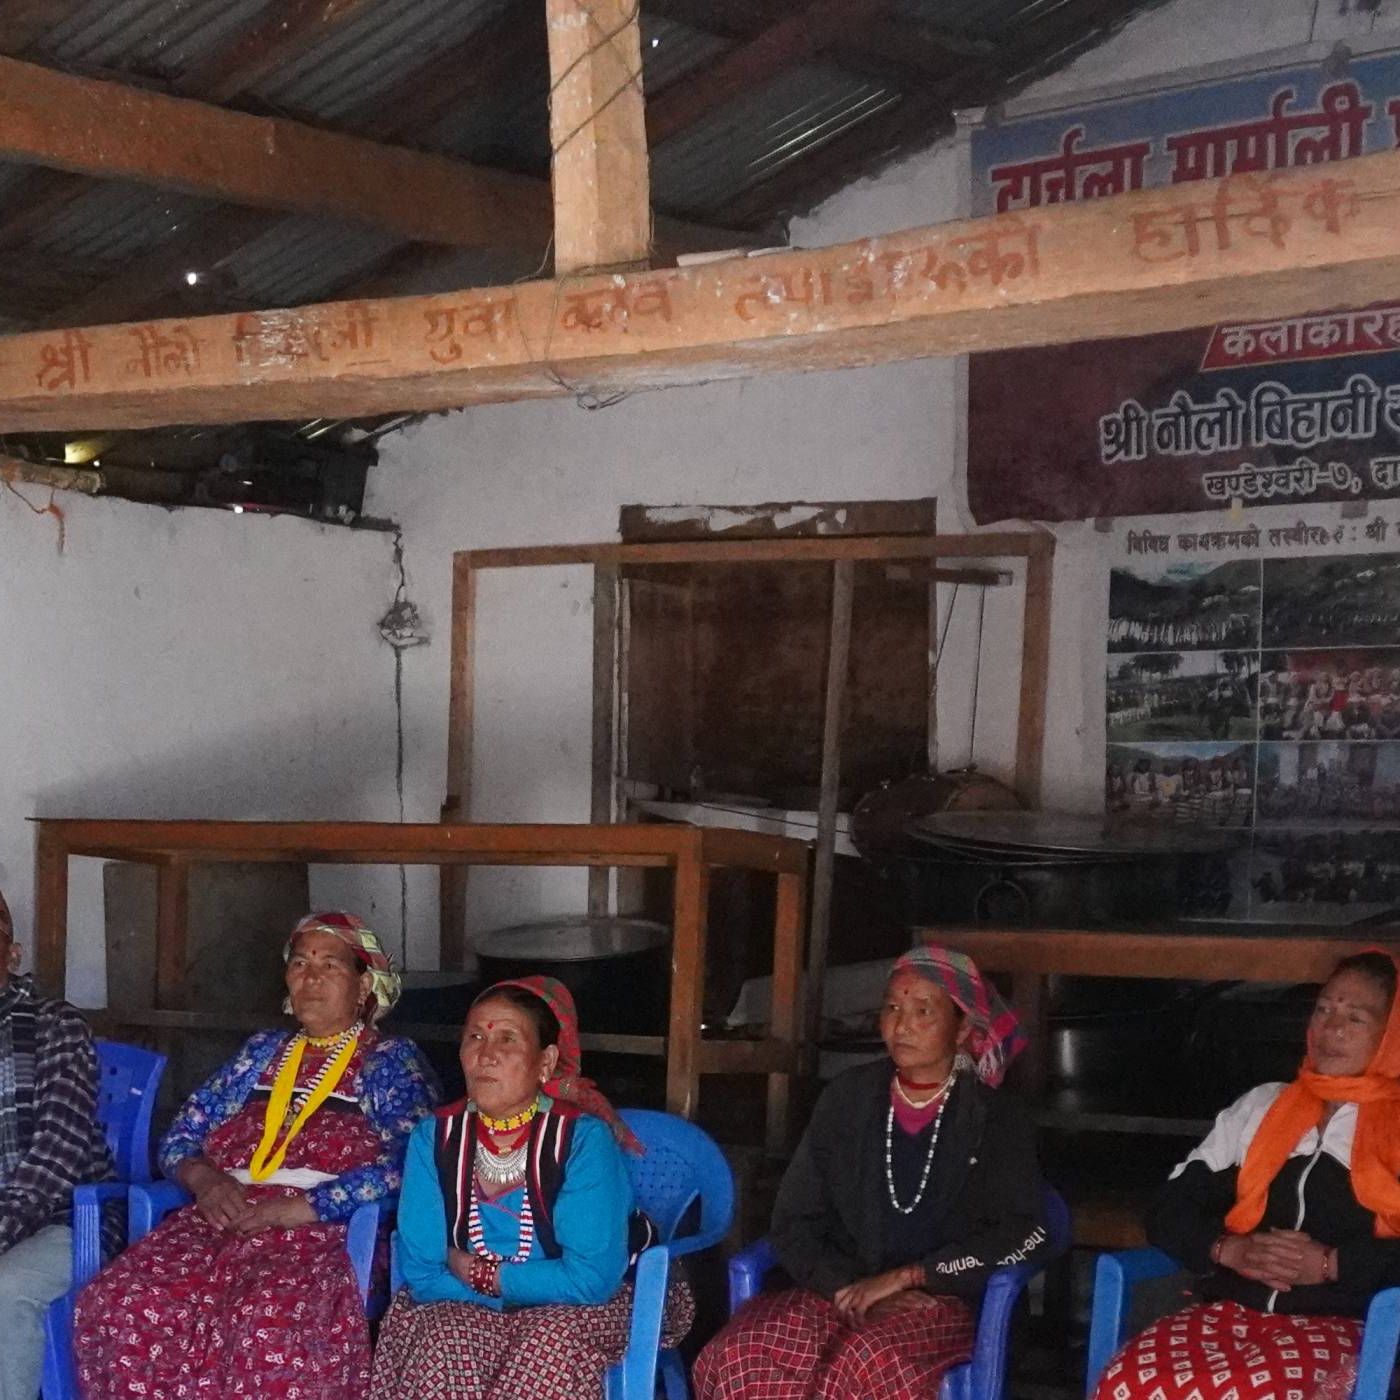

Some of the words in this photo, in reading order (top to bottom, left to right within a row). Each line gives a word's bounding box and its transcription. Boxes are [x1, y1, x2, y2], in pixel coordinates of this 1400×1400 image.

[1100, 400, 1147, 463] श्री
[1152, 387, 1246, 455] नौलो
[1252, 375, 1380, 447] बिहानी
